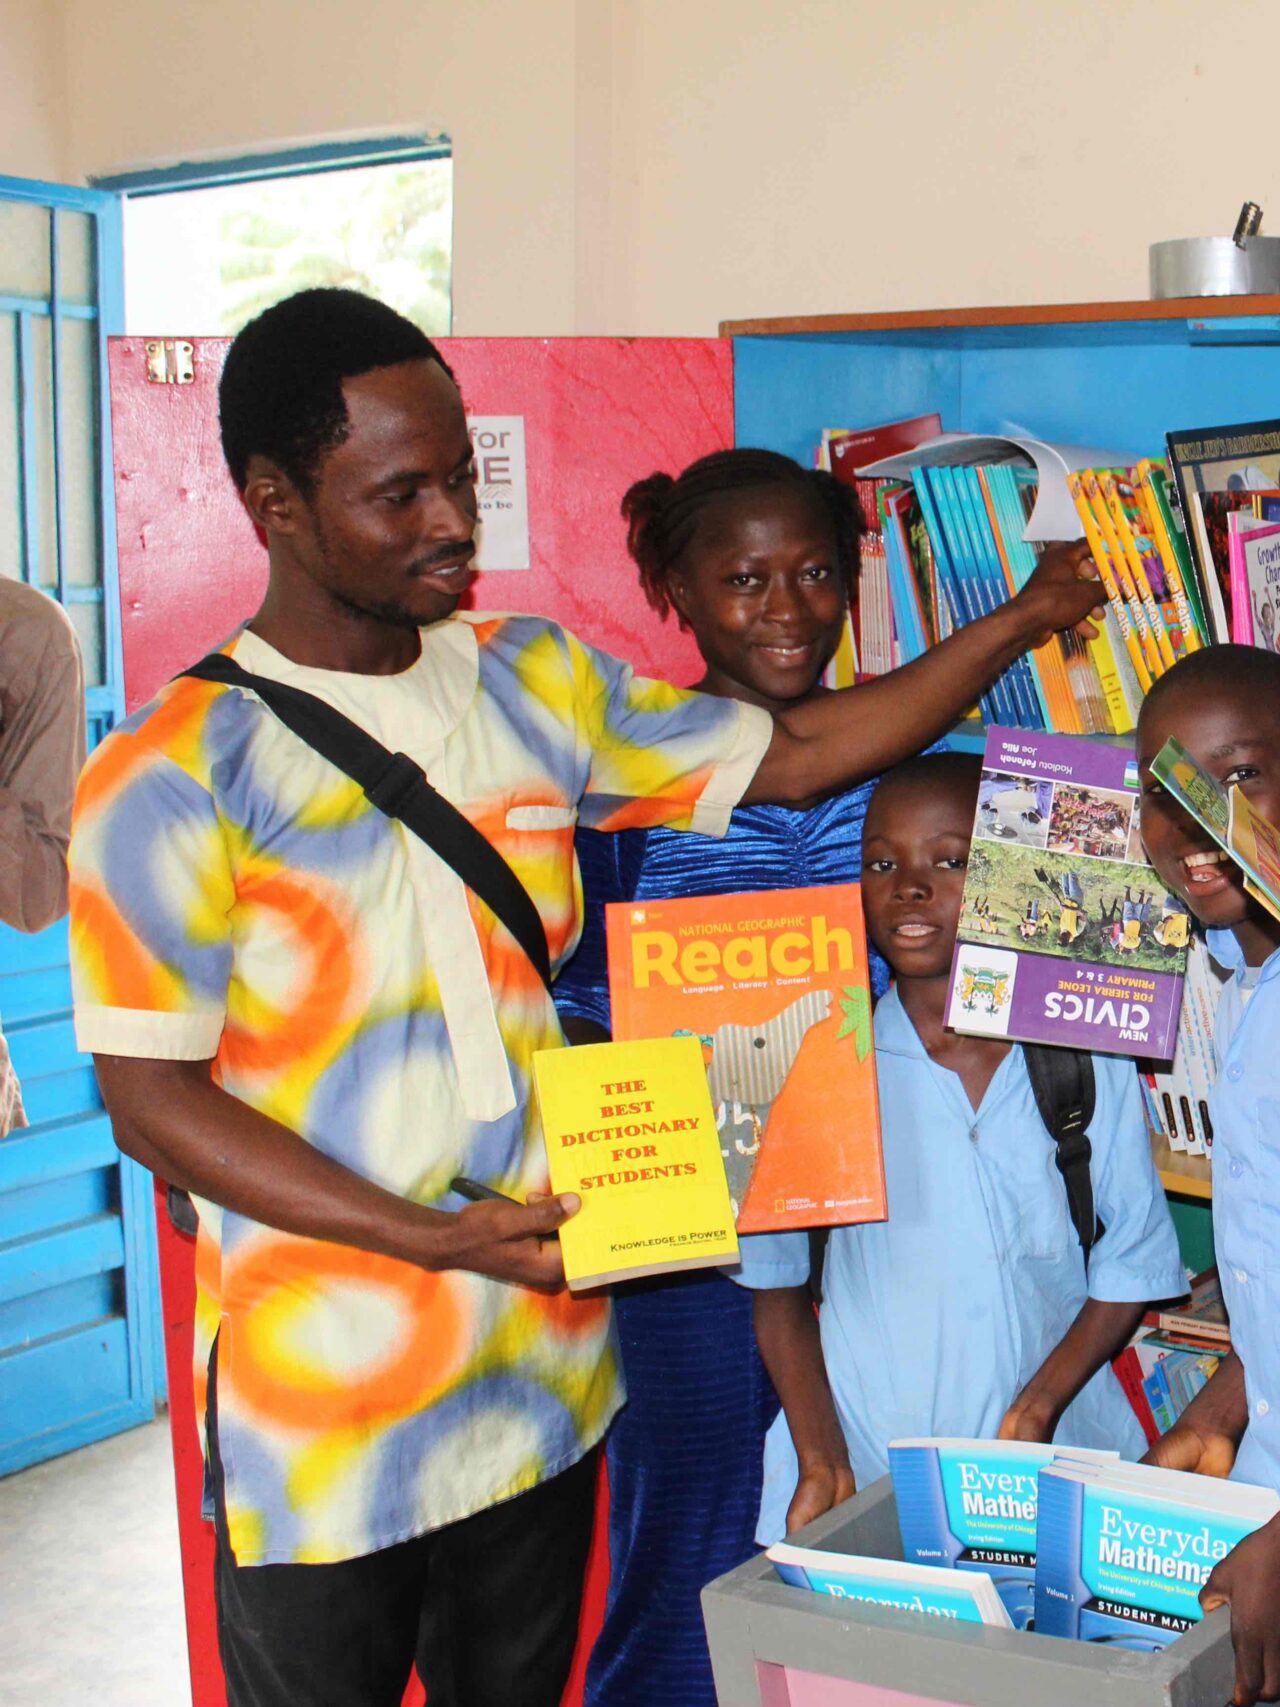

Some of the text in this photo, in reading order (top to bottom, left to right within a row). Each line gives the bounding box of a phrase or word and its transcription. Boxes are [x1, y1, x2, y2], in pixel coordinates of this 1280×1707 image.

[469, 427, 511, 449] for
[496, 501, 512, 509] be
[1021, 745, 1038, 756] Joe
[1038, 760, 1073, 775] Kadiatu
[679, 915, 806, 937] NATIONAL GEOGRAPHIC
[631, 915, 855, 989] Reach
[683, 976, 811, 995] Language Literacy Content
[1076, 970, 1156, 990] PRIMARY 3 & 4
[1058, 980, 1154, 1002] FOR SIERRA LEONE
[1044, 991, 1150, 1030] CIVICS
[1119, 1030, 1149, 1042] NEW
[601, 1080, 647, 1096] THE
[600, 1100, 655, 1119] BEST
[559, 1118, 699, 1148] DICTIONARY
[611, 1144, 658, 1162] FOR
[579, 1162, 697, 1190] STUDENTS
[957, 1462, 1038, 1500] Every
[962, 1491, 1037, 1520] Mathe
[916, 1549, 941, 1557] Volume
[971, 1550, 1026, 1564] STUDENT
[1098, 1537, 1212, 1585] Mathema
[1099, 1568, 1110, 1577] The
[1110, 1569, 1141, 1586] University
[1150, 1579, 1175, 1592] Chicago
[1176, 1586, 1196, 1597] School
[1046, 1586, 1075, 1602] Volume 1
[1097, 1600, 1156, 1623] STUDENT
